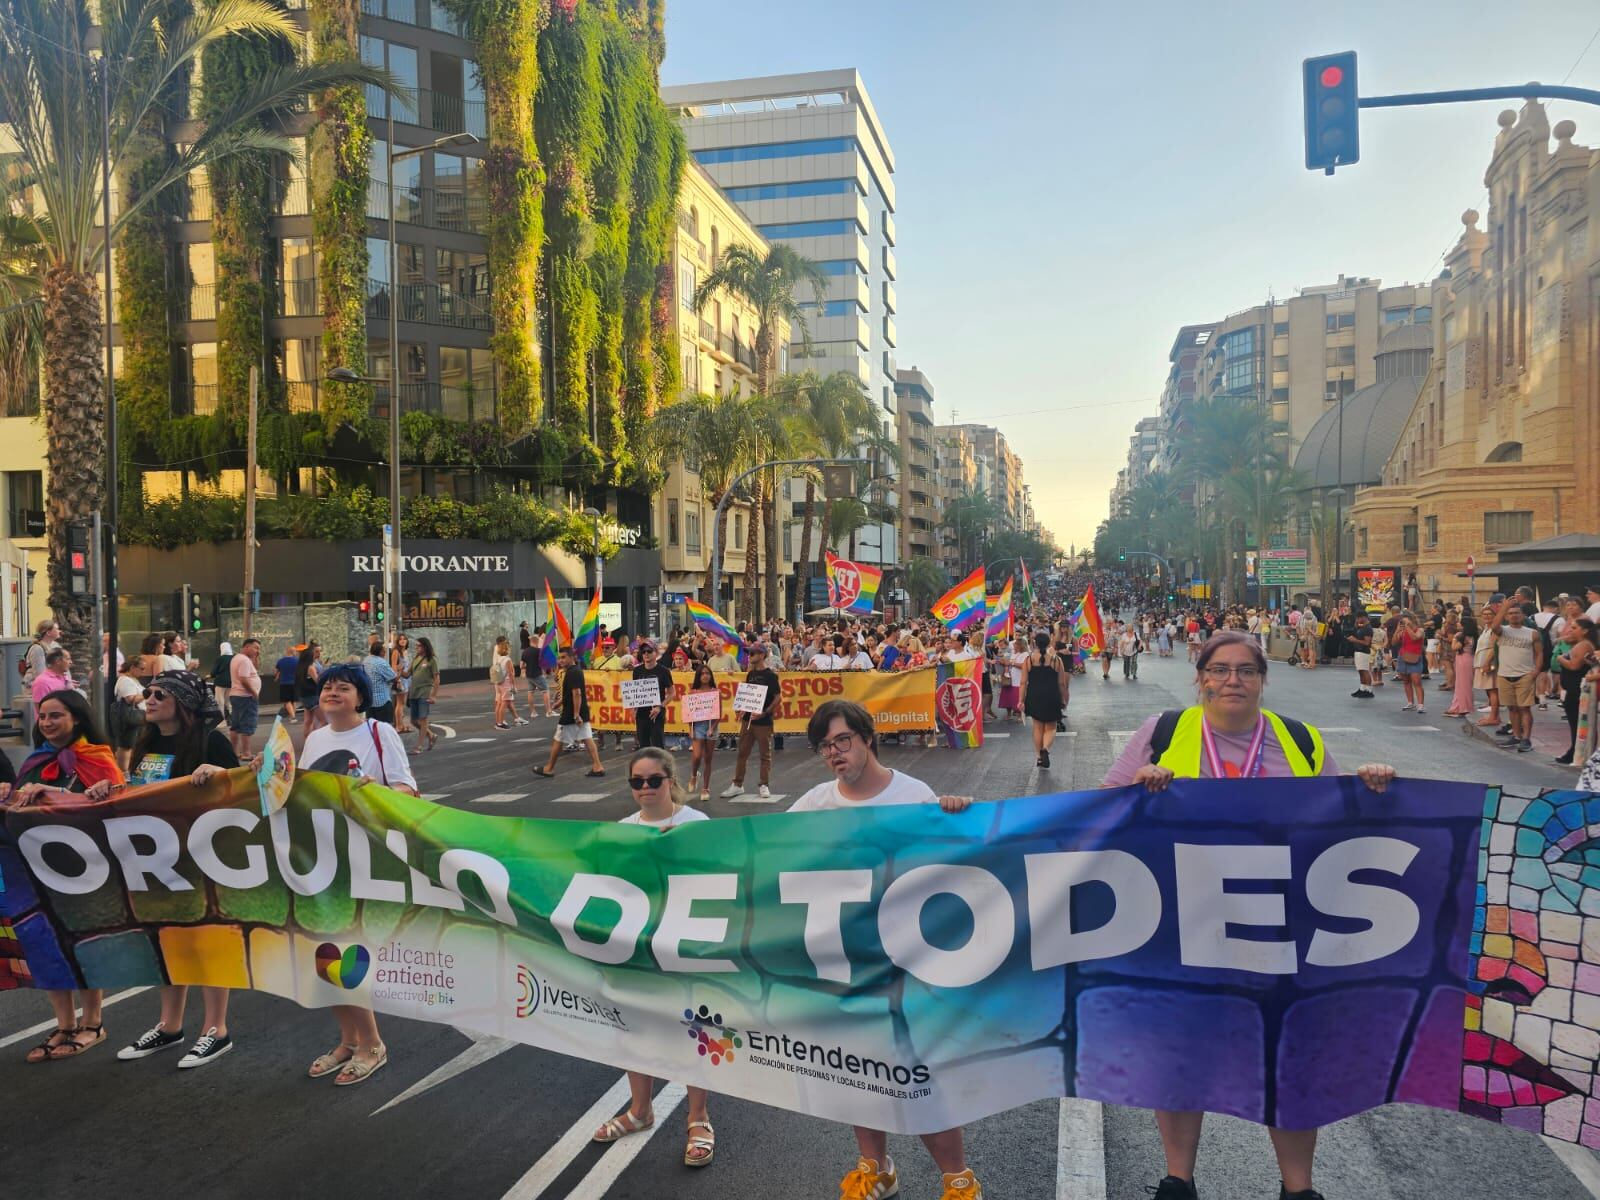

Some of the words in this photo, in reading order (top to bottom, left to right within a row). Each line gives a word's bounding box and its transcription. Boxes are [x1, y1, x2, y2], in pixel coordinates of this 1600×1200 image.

[420, 599, 465, 619] Mafia
[18, 808, 519, 927] ORGULLO
[549, 872, 740, 973] DE
[778, 836, 1421, 988] TODES
[377, 941, 454, 969] alicante
[376, 965, 455, 990] entiende
[374, 987, 455, 1006] colectivolgbi+
[747, 1030, 931, 1086] Entendemos
[749, 1054, 786, 1071] ASOCIACIÓN
[786, 1062, 796, 1073] DE
[795, 1065, 830, 1082] PERSONAS
[836, 1075, 867, 1090] LOCALES
[867, 1083, 908, 1100] AMIGABLES
[908, 1087, 932, 1100] LGTBI
